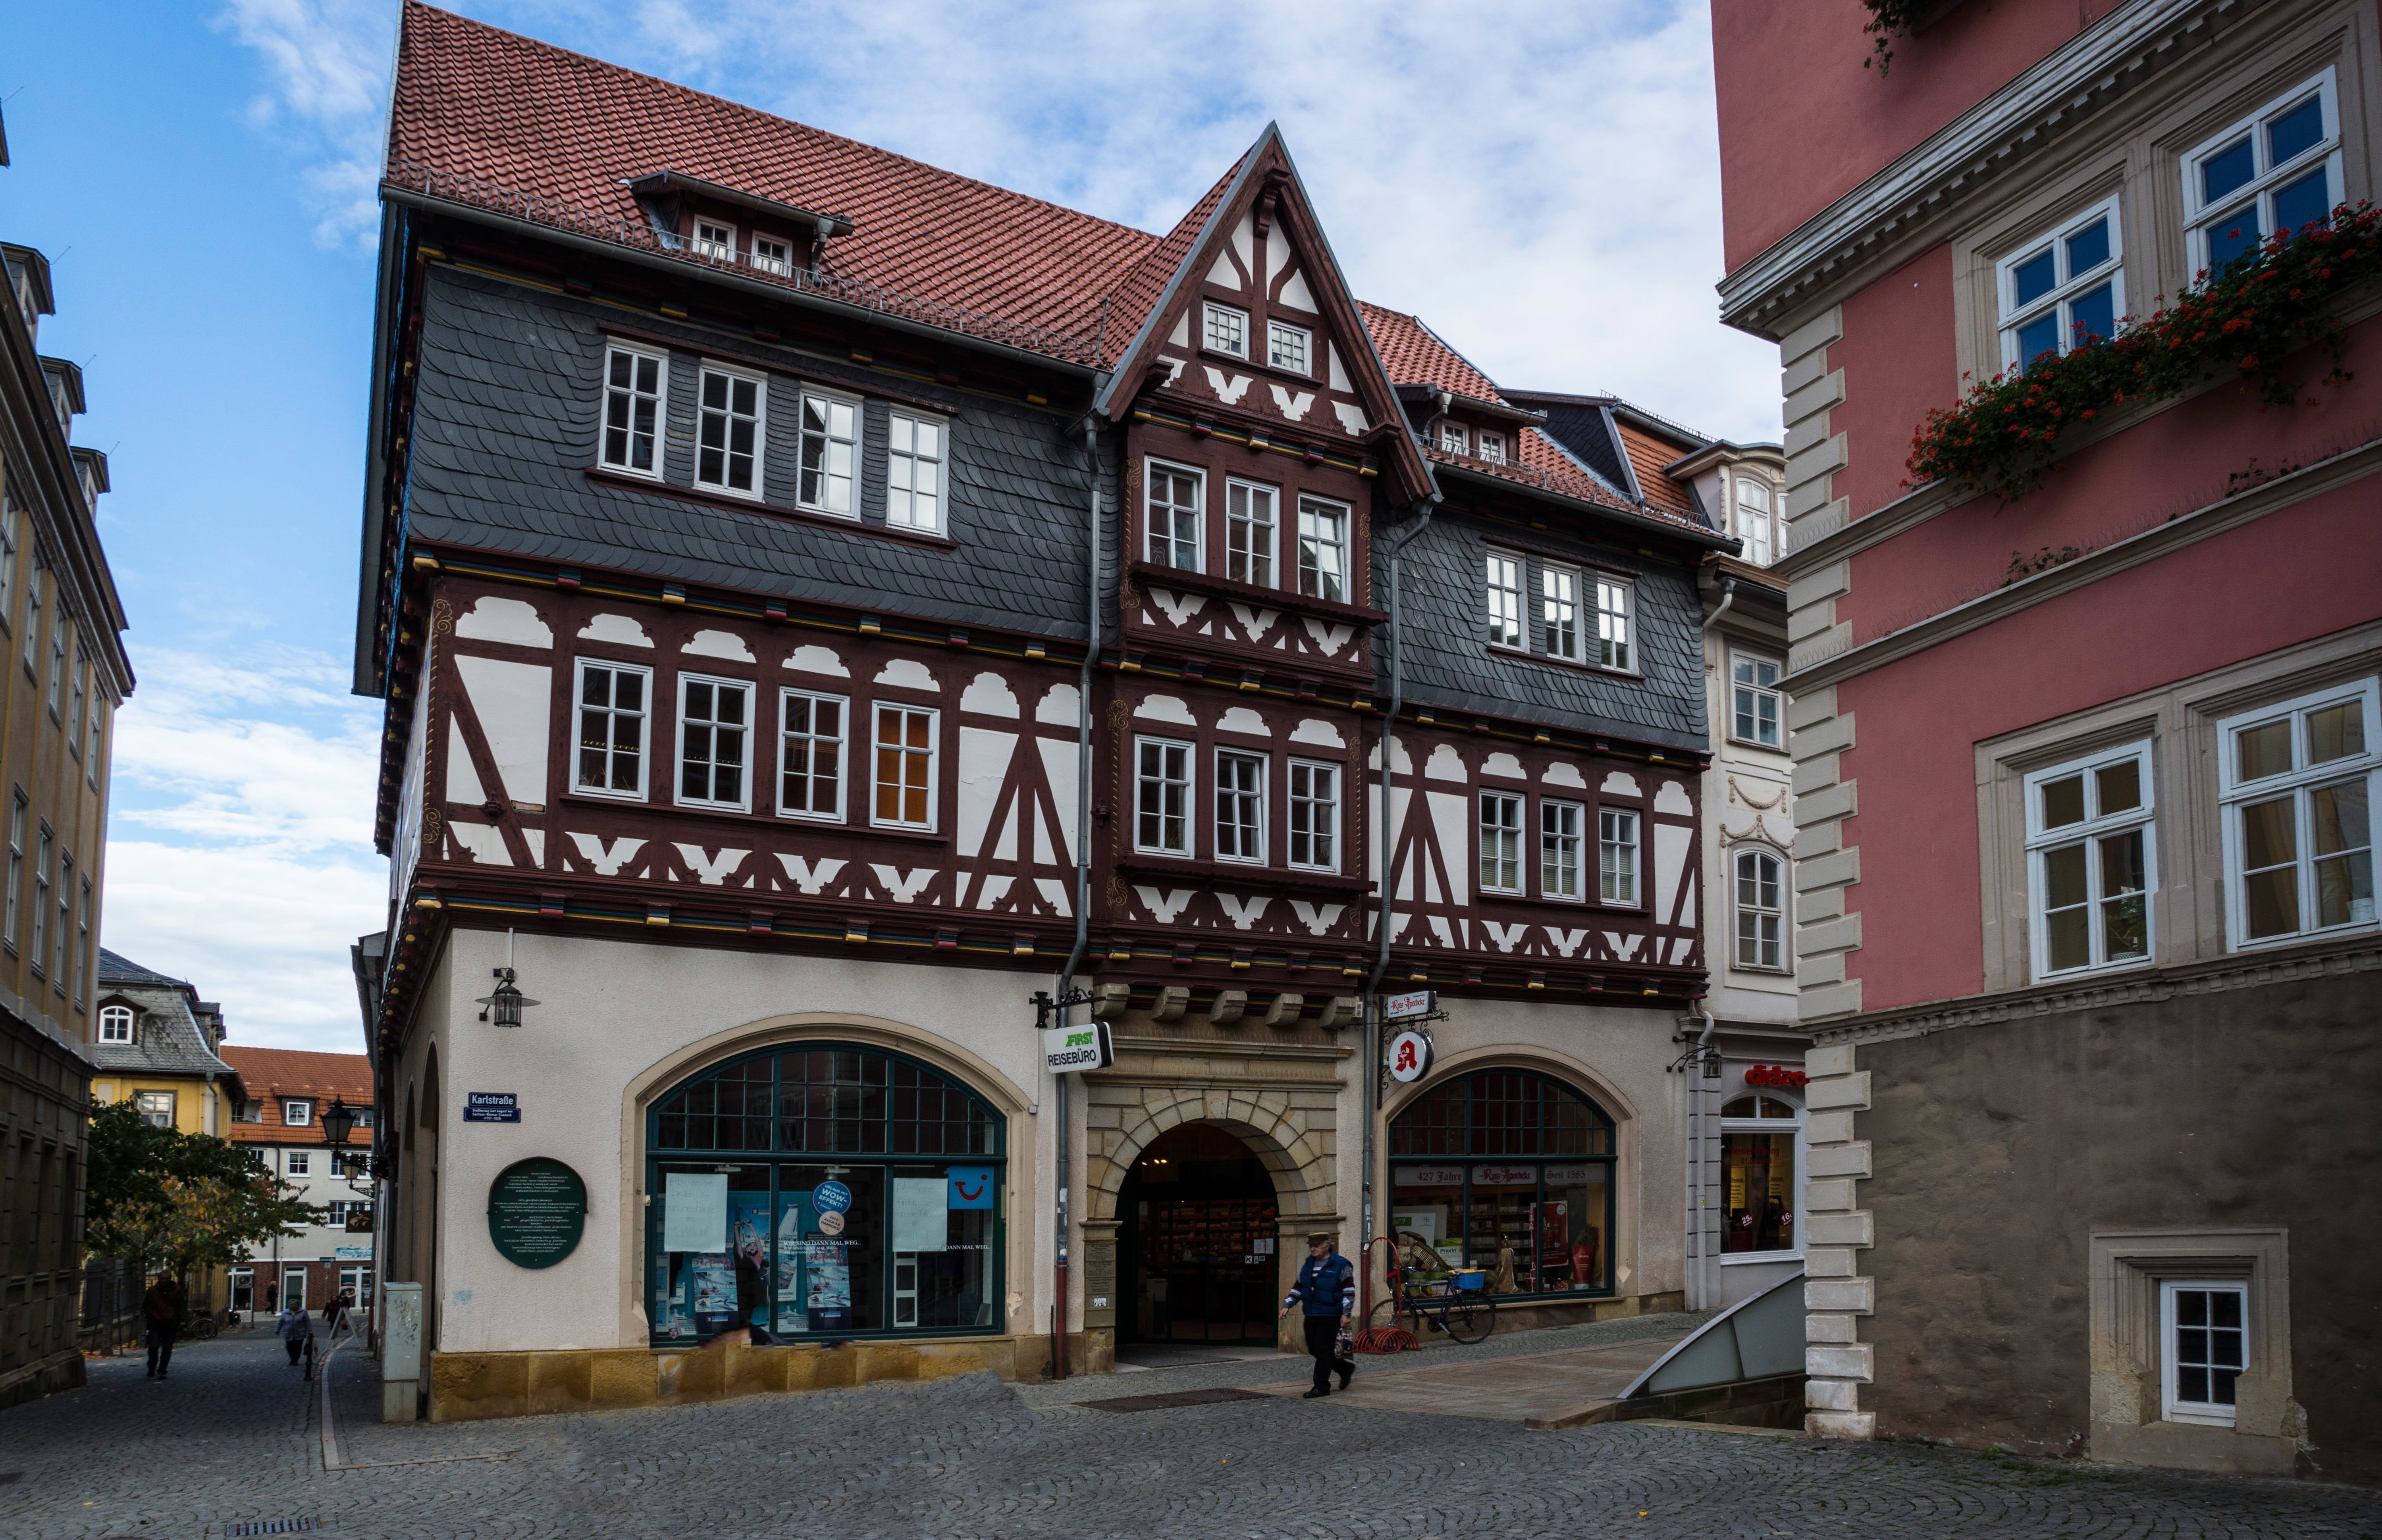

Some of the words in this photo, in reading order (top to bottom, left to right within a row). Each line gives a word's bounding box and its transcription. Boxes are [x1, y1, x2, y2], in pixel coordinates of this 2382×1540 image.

[1390, 1000, 1404, 1012] Rats
[1066, 1032, 1093, 1047] FIRST
[1048, 1048, 1096, 1066] REISEBÜRO
[472, 1095, 513, 1105] Karlstraße
[1417, 1172, 1434, 1181] 427
[1437, 1171, 1462, 1182] Jahre
[1547, 1170, 1564, 1179] Seit
[825, 1184, 840, 1193] URLAUB
[822, 1188, 847, 1202] WOW-
[818, 1195, 843, 1208] EFFEKT!
[821, 1220, 841, 1231] HAMBURG!
